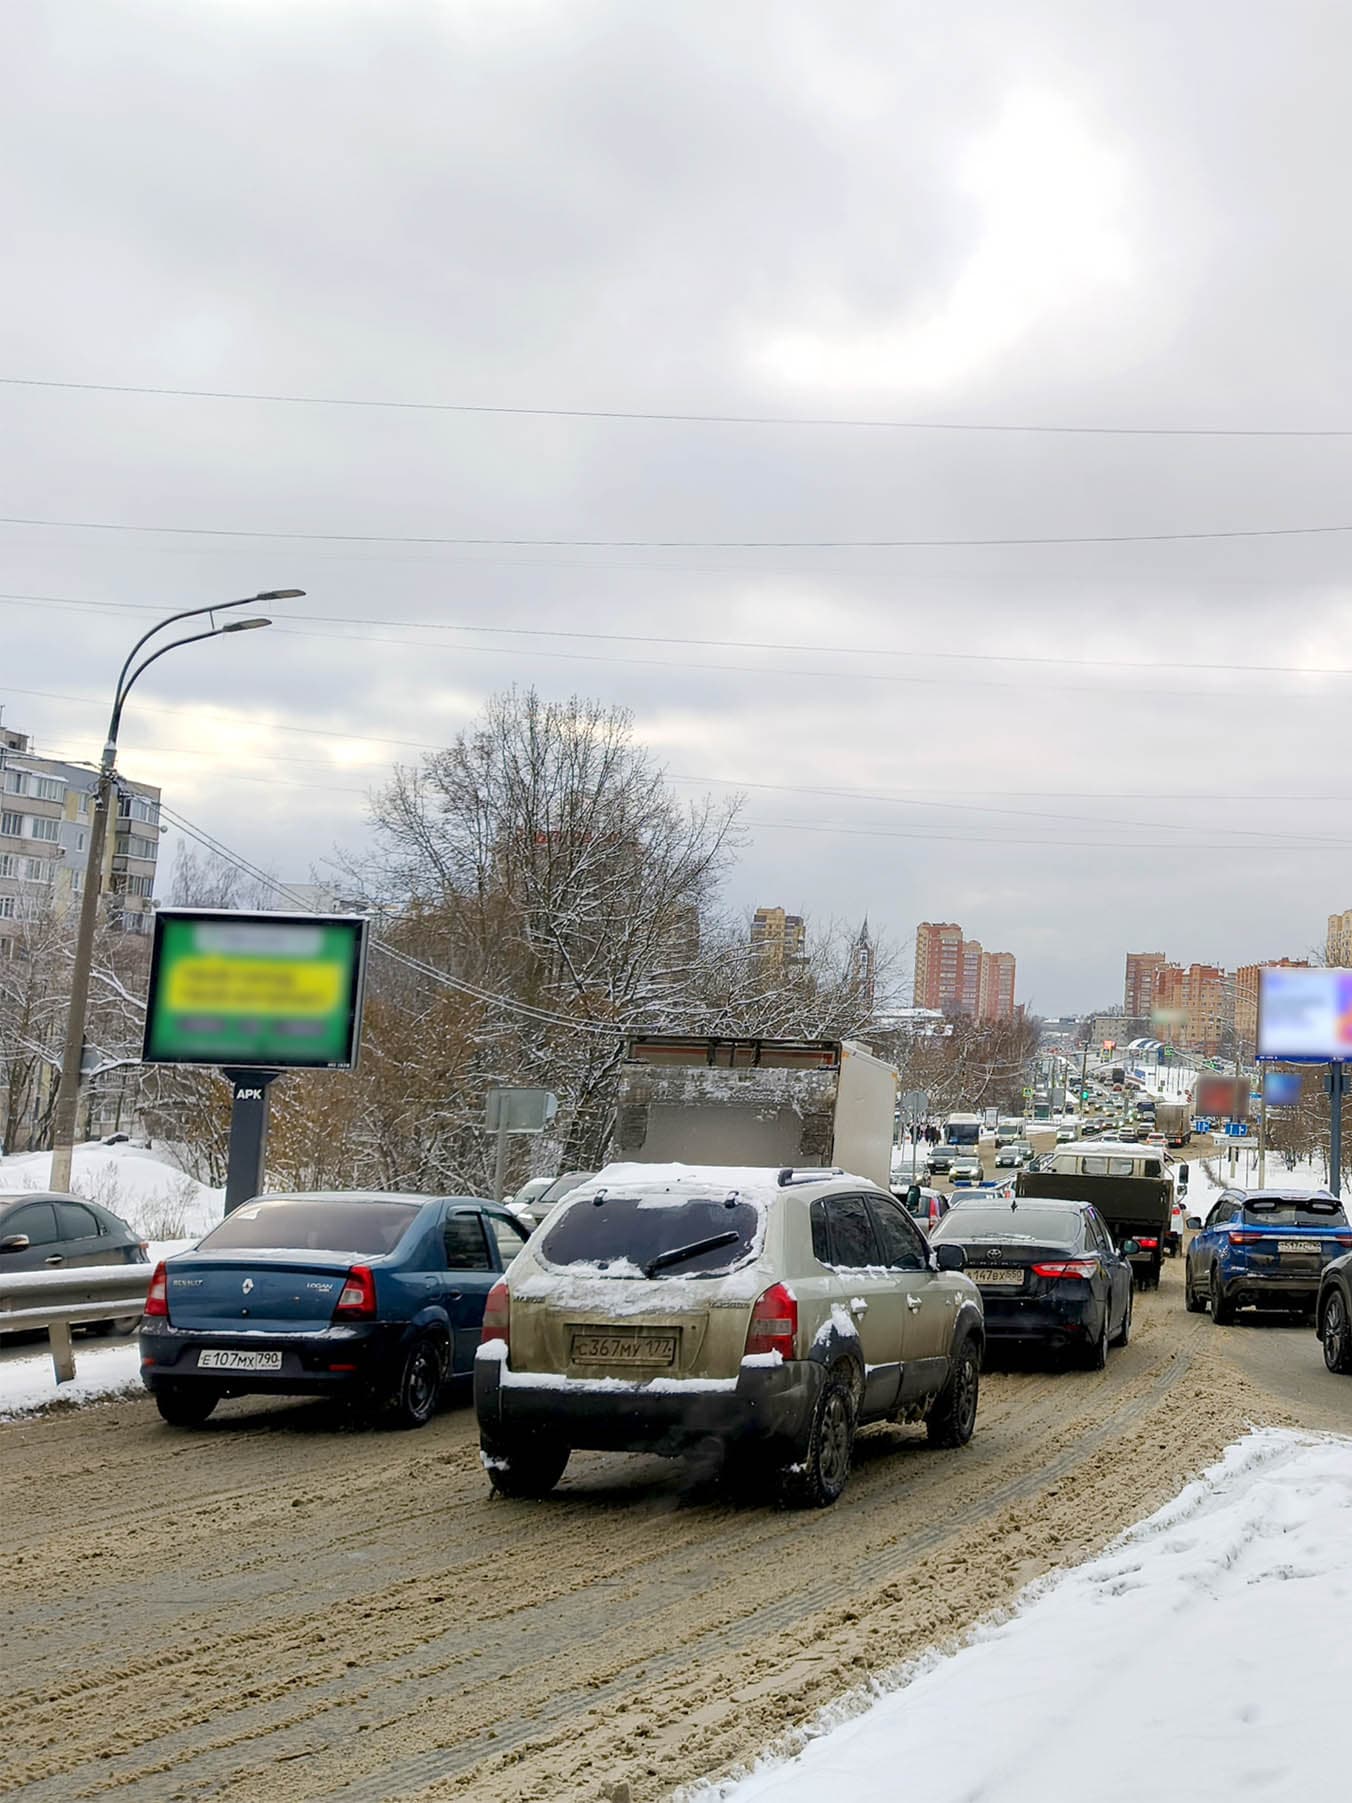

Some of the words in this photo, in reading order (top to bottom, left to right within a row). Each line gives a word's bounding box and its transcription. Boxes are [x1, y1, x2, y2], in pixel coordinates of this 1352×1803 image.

[577, 1338, 641, 1356] С367МУ
[202, 1351, 255, 1366] Е107МХ
[257, 1352, 279, 1364] 790
